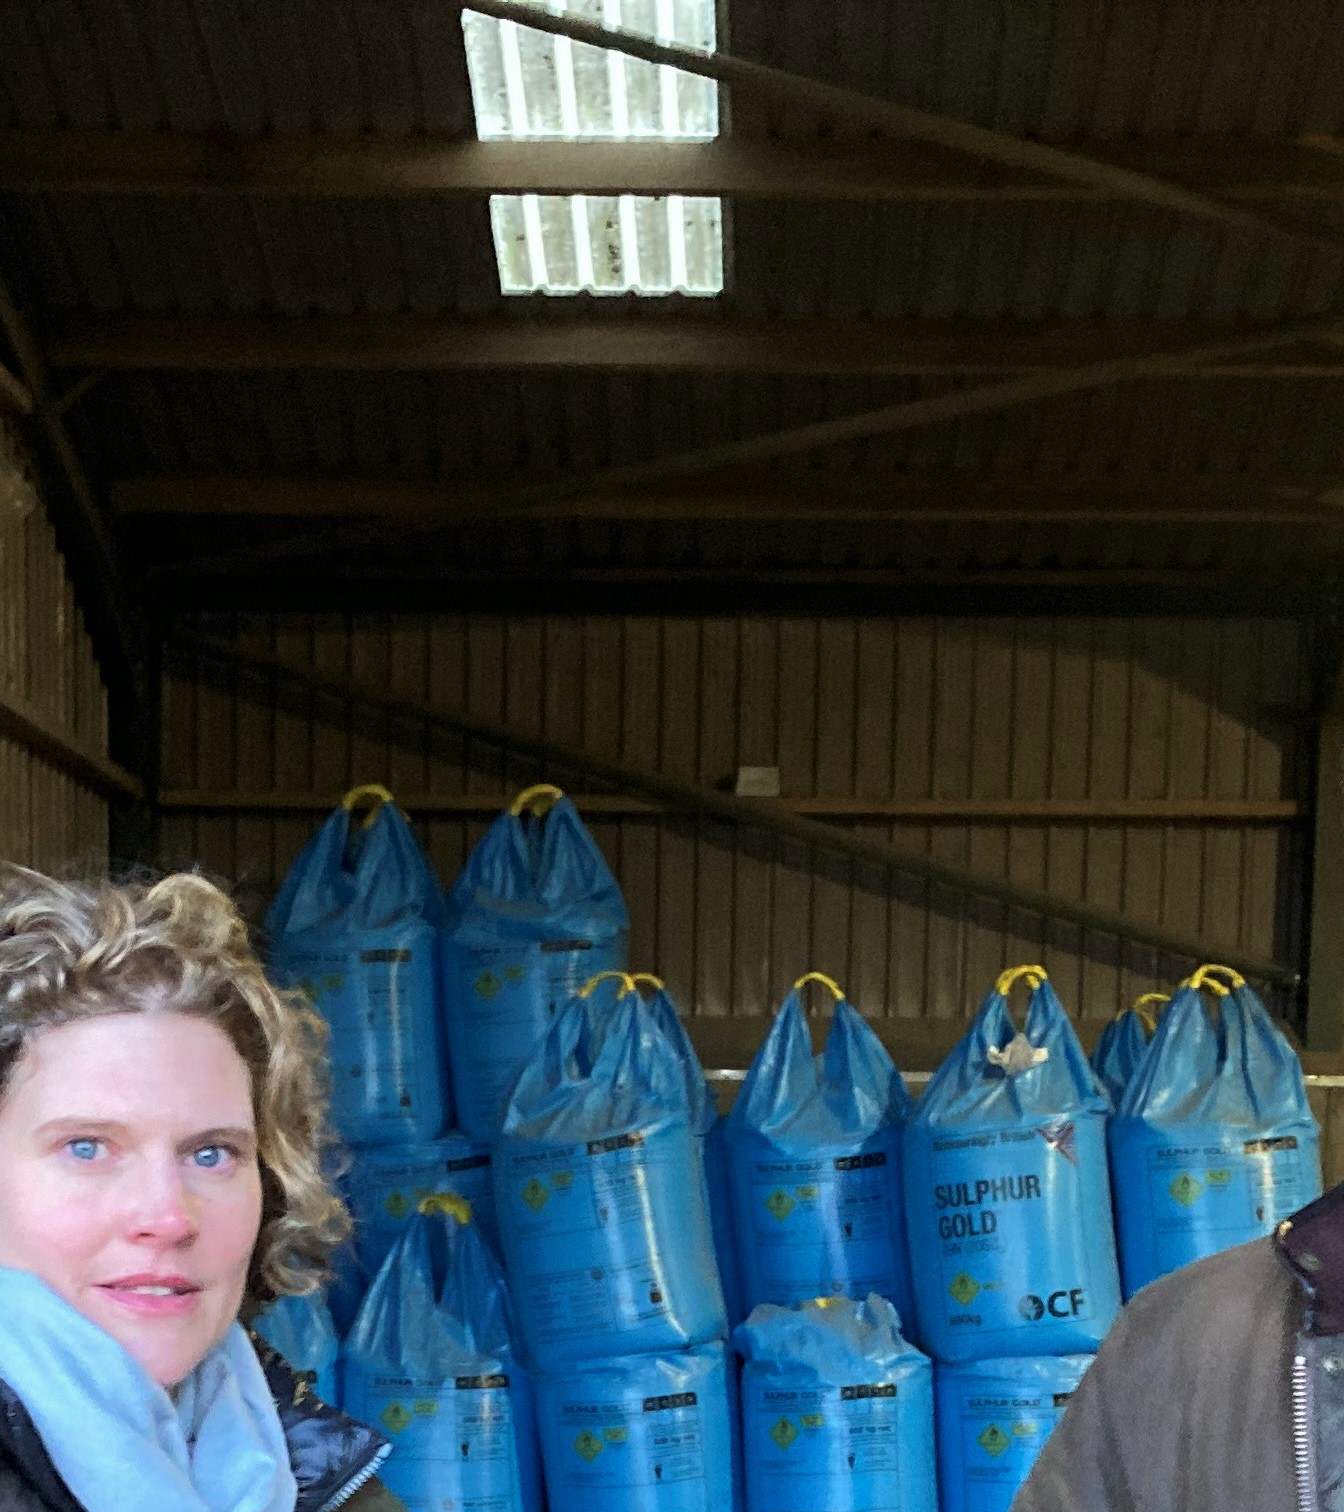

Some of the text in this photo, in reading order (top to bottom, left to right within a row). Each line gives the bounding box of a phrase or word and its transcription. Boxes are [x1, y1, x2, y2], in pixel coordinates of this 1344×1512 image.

[934, 1175, 1041, 1209] SULPHUR
[938, 1210, 997, 1239] GOLD
[1048, 1288, 1085, 1318] CF
